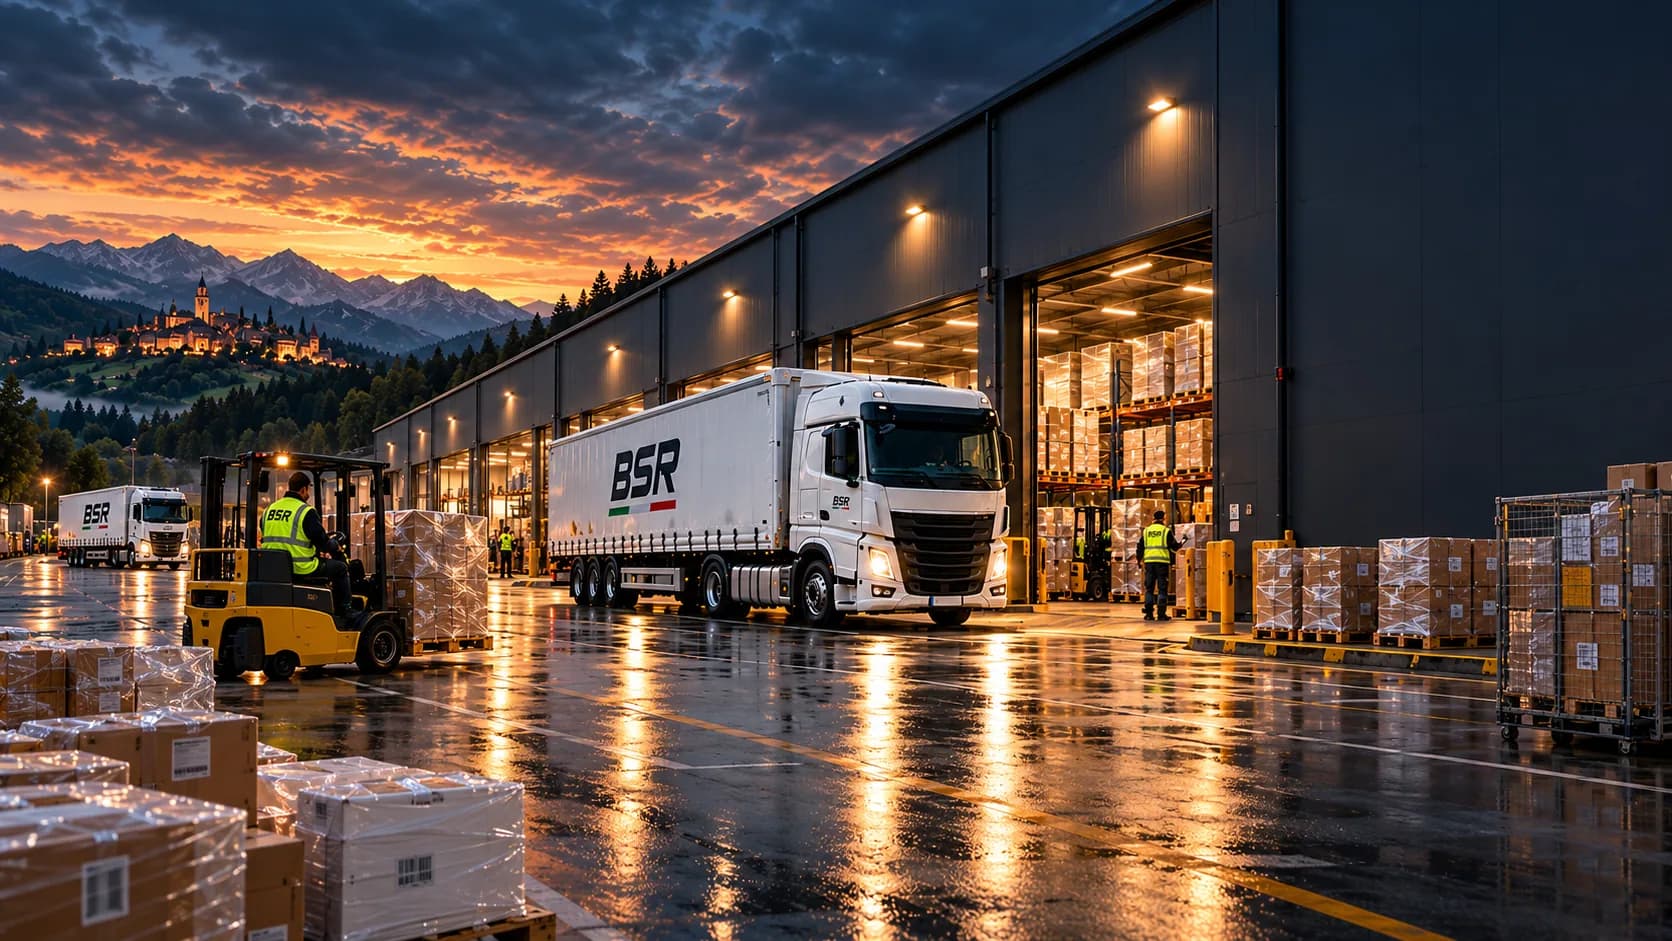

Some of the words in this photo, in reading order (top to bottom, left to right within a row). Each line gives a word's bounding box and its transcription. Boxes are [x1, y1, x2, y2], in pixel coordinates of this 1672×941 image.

[610, 438, 681, 502] BSR
[832, 495, 850, 507] BSR
[83, 502, 110, 525] BSR
[267, 509, 292, 522] BSR
